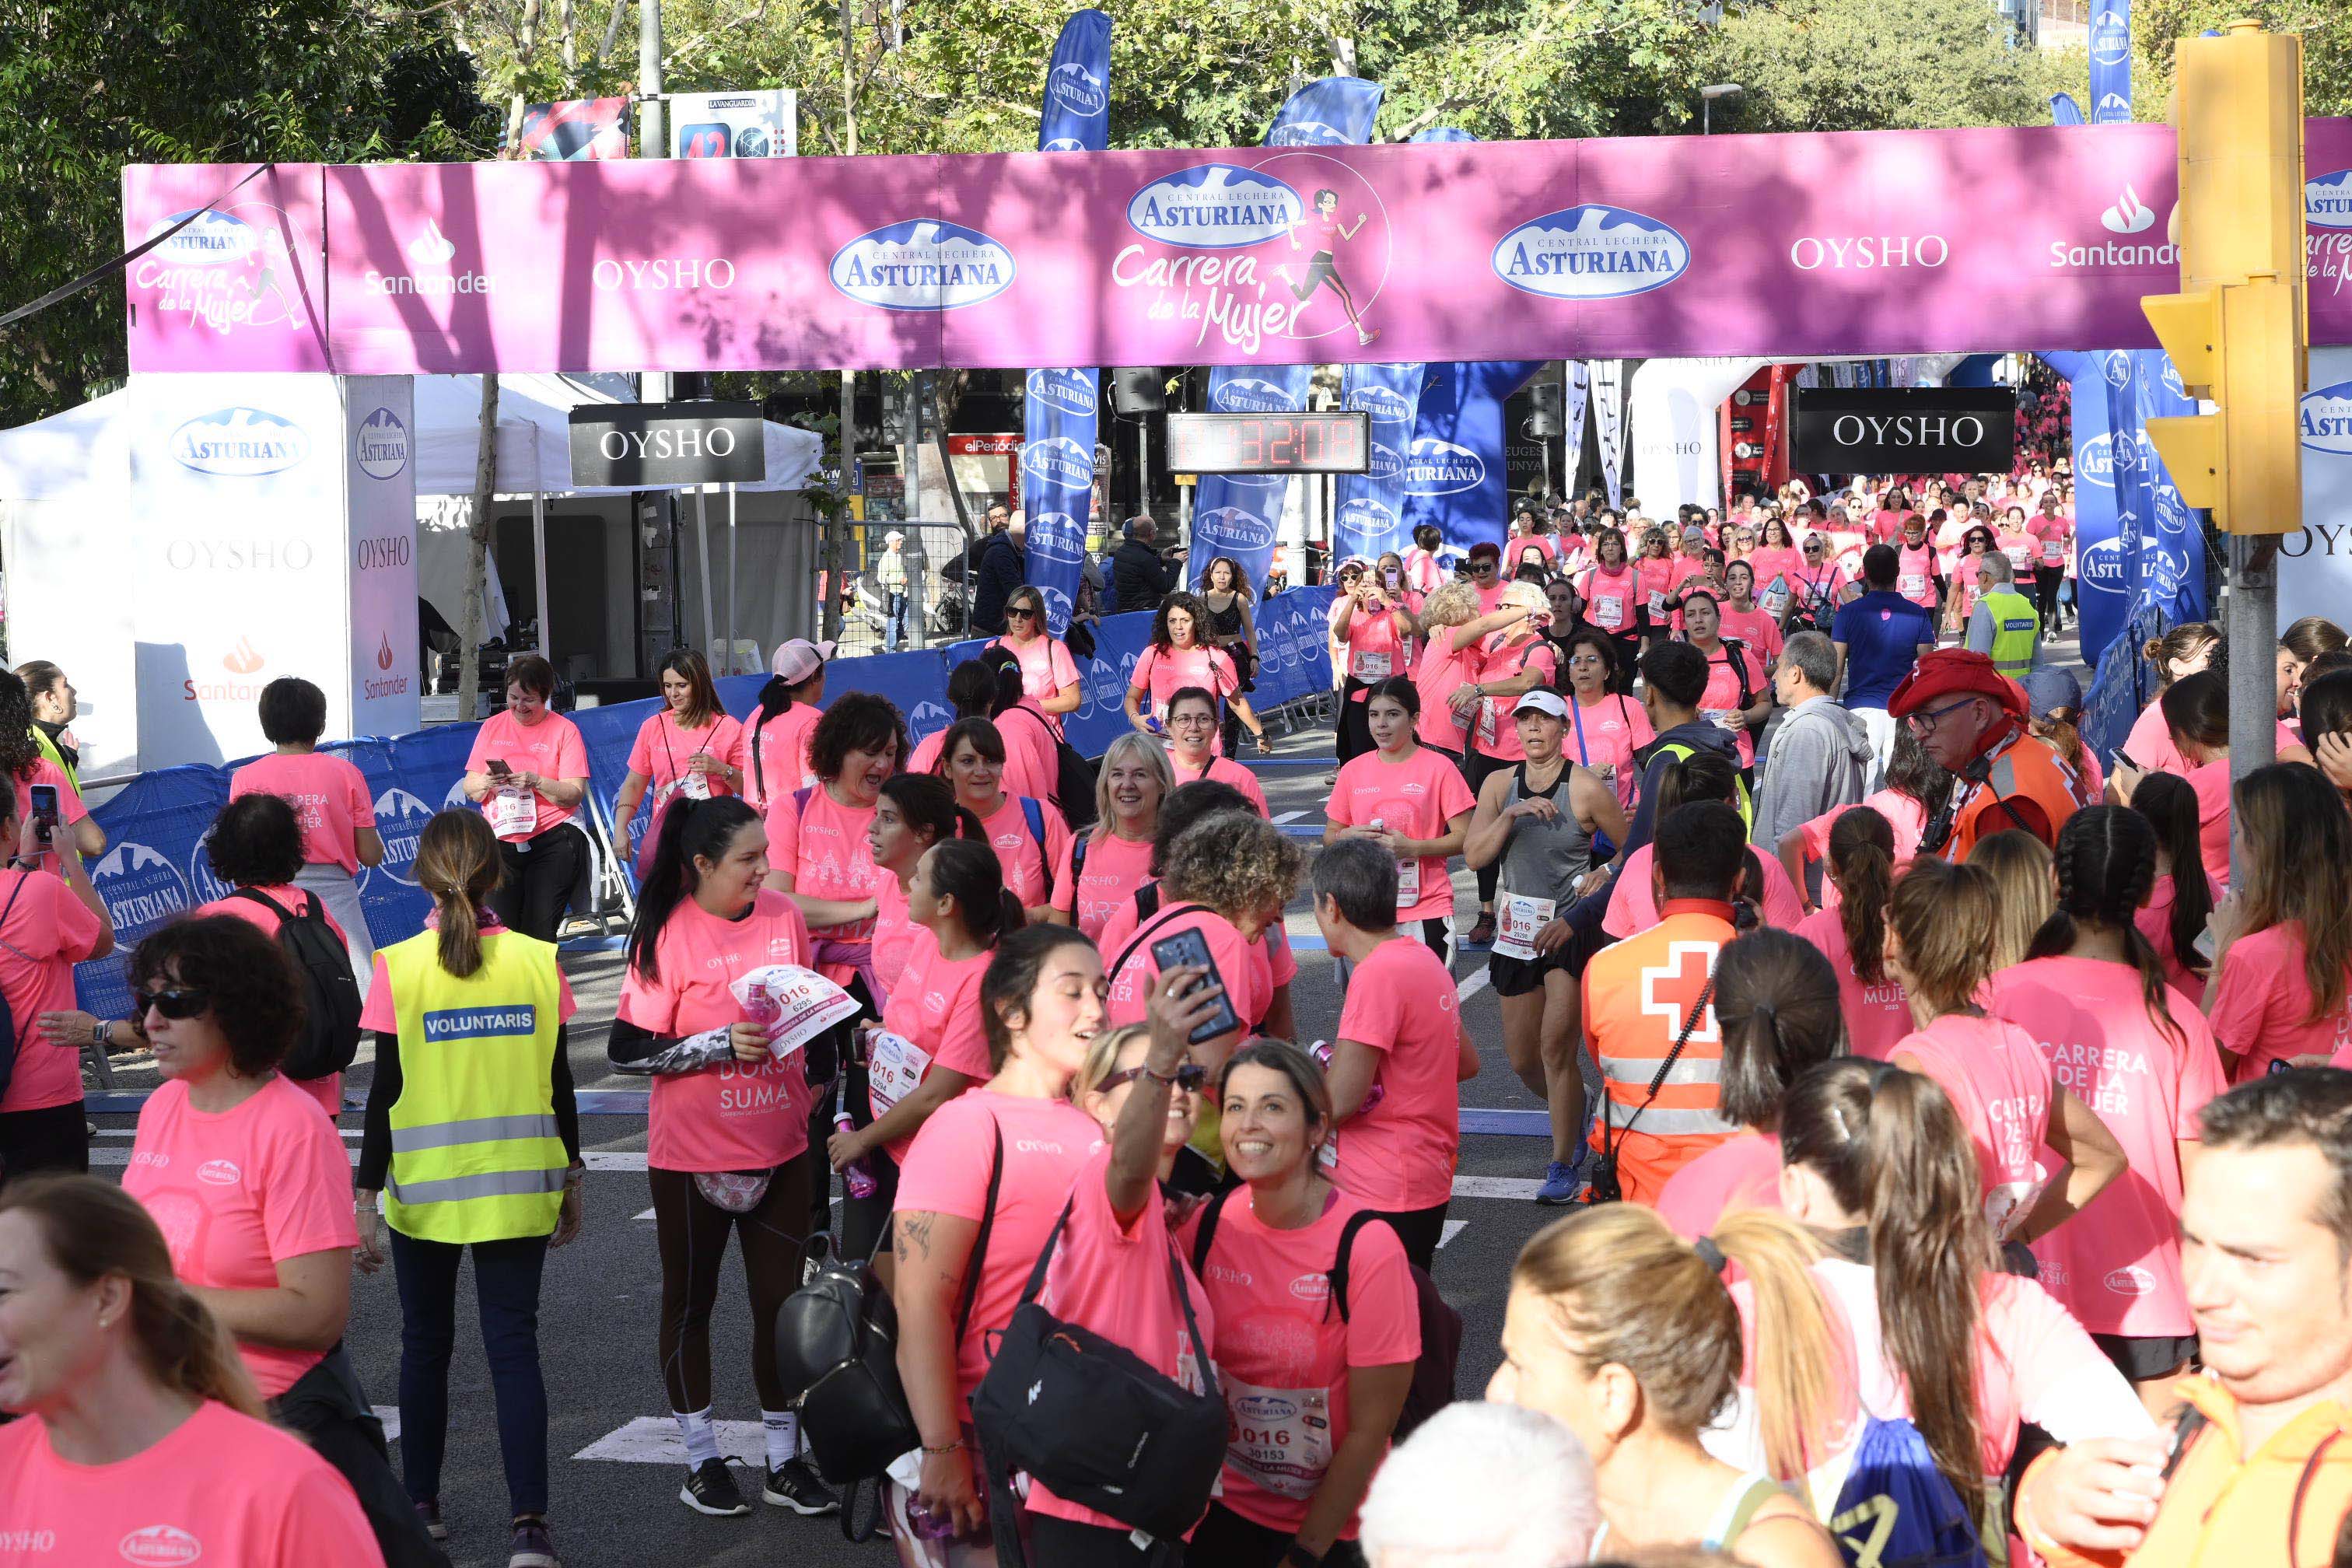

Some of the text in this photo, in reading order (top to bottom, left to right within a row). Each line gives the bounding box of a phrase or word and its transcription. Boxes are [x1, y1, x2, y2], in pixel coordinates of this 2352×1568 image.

[1168, 191, 1286, 202] CENTRAL LECHERA
[1140, 195, 1289, 227] ASTURIANA
[1538, 236, 1669, 247] CENTRAL LECHERA
[1790, 236, 1949, 269] OYSHO
[873, 250, 996, 261] CENTRAL LECHERA
[1112, 243, 1258, 286] Carrera
[1507, 242, 1675, 276] ASTURIANA
[2323, 256, 2337, 278] la
[136, 261, 229, 289] Carrera
[365, 270, 499, 295] Santander
[593, 258, 736, 290] OYSHO
[844, 254, 1002, 287] ASTURIANA
[158, 287, 262, 335] de la Mujer
[1148, 280, 1312, 355] de la Mujer
[1033, 377, 1094, 411] ASTURIANA
[600, 427, 736, 460] OYSHO
[1832, 415, 1984, 447] OYSHO
[360, 435, 405, 462] ASTURIANA
[1029, 452, 1091, 484] ASTURIANA
[1370, 459, 1398, 473] RIANA
[1406, 464, 1478, 481] TURIANA
[1026, 525, 1084, 558] ASTURIANA
[1199, 520, 1265, 545] ASTURIANA
[358, 536, 409, 570] OYSHO
[365, 675, 408, 701] Santander
[805, 824, 839, 838] OYSHO
[111, 885, 186, 930] STURIANA
[1513, 920, 1531, 931] 016
[779, 985, 810, 1005] 016
[793, 998, 813, 1012] 6295
[426, 1010, 533, 1036] VOLUNTARIS
[775, 1018, 799, 1037] CARRERA
[814, 999, 831, 1013] MUJER
[779, 1028, 807, 1049] OYSHO
[873, 1060, 894, 1083] 016
[2056, 1065, 2127, 1093] DE LA
[720, 1082, 789, 1109] SUMA
[873, 1078, 887, 1092] 6294
[1206, 1263, 1252, 1286] OYSHO
[1239, 1402, 1293, 1416] ASTURIANA
[1243, 1428, 1290, 1445] 016
[127, 1538, 194, 1561] ASTURIANA
